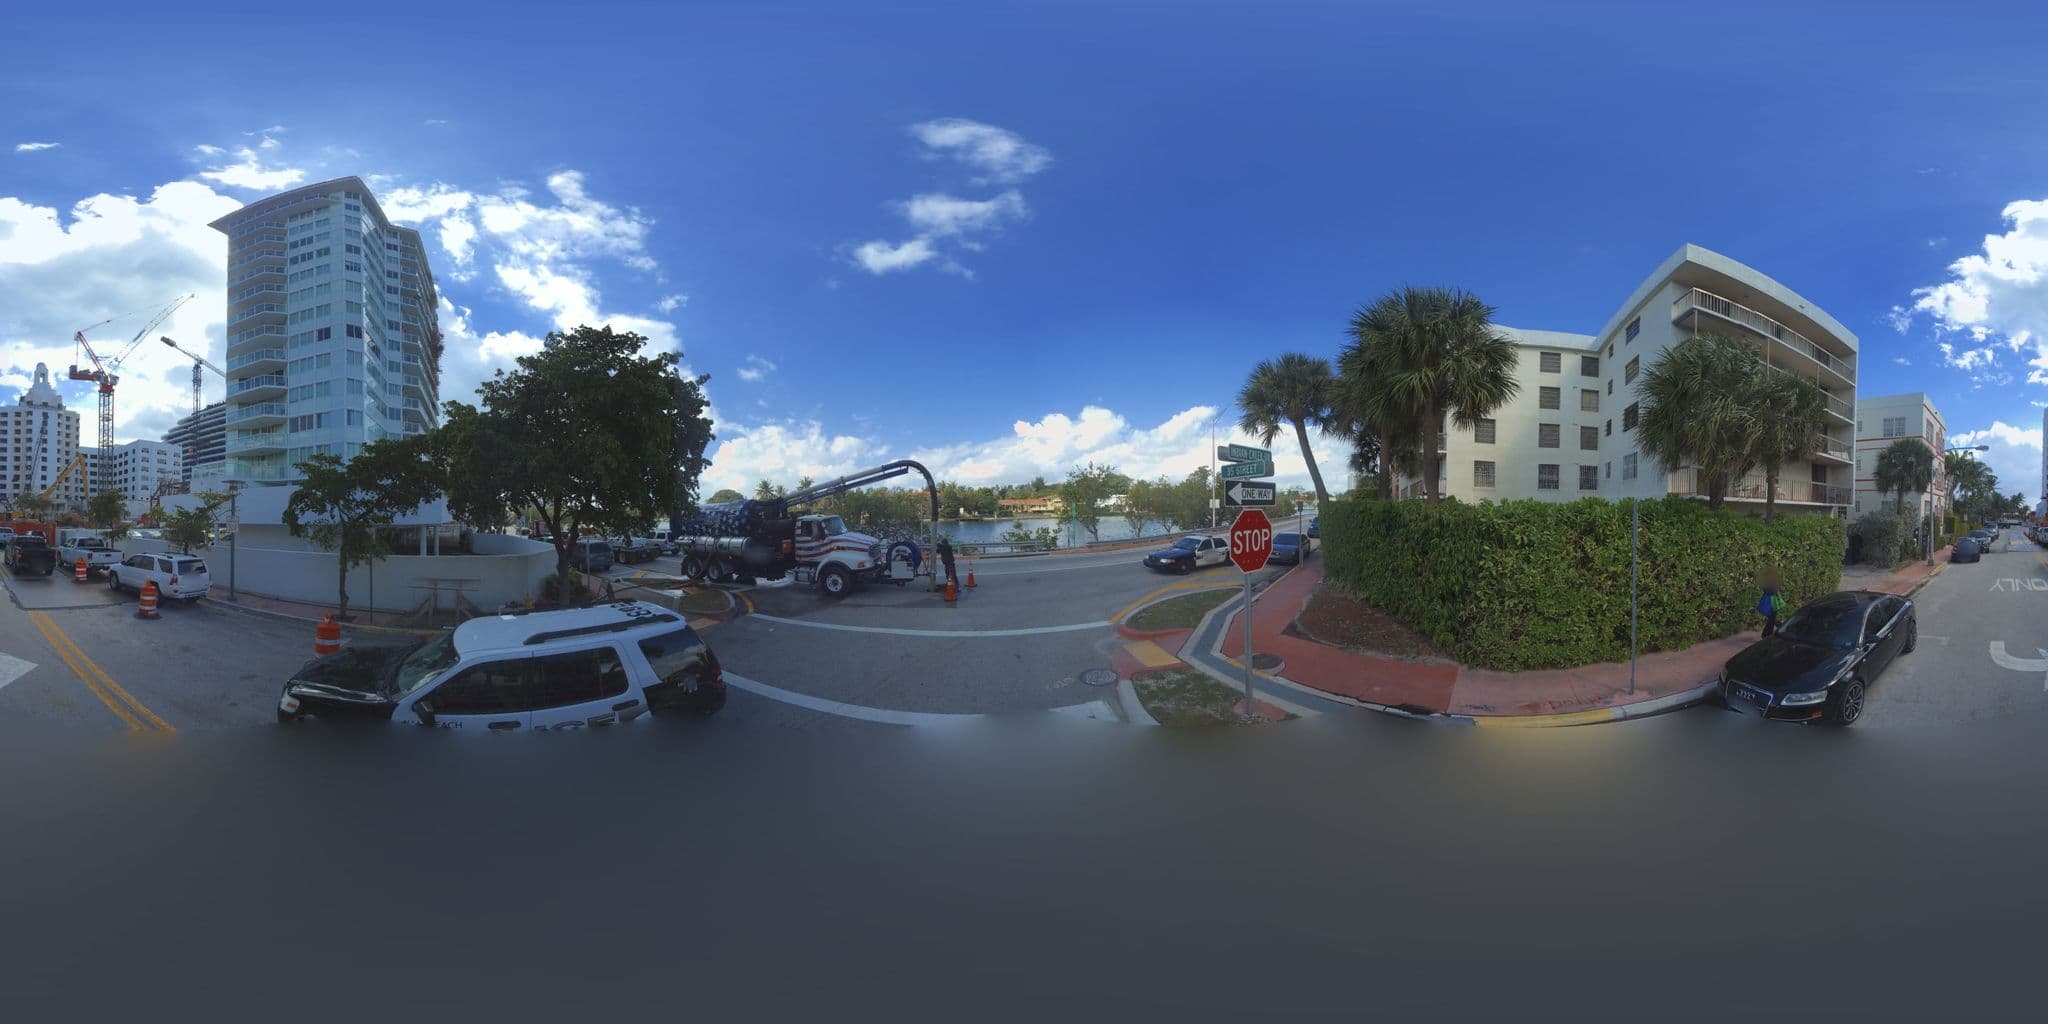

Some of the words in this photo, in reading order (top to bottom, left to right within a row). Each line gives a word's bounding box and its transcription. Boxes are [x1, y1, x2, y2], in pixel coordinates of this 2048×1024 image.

[1236, 463, 1257, 475] STREET
[1241, 488, 1256, 499] ONE
[1257, 488, 1272, 499] WAY
[1233, 528, 1270, 555] STOP
[1988, 578, 2048, 592] ONLY
